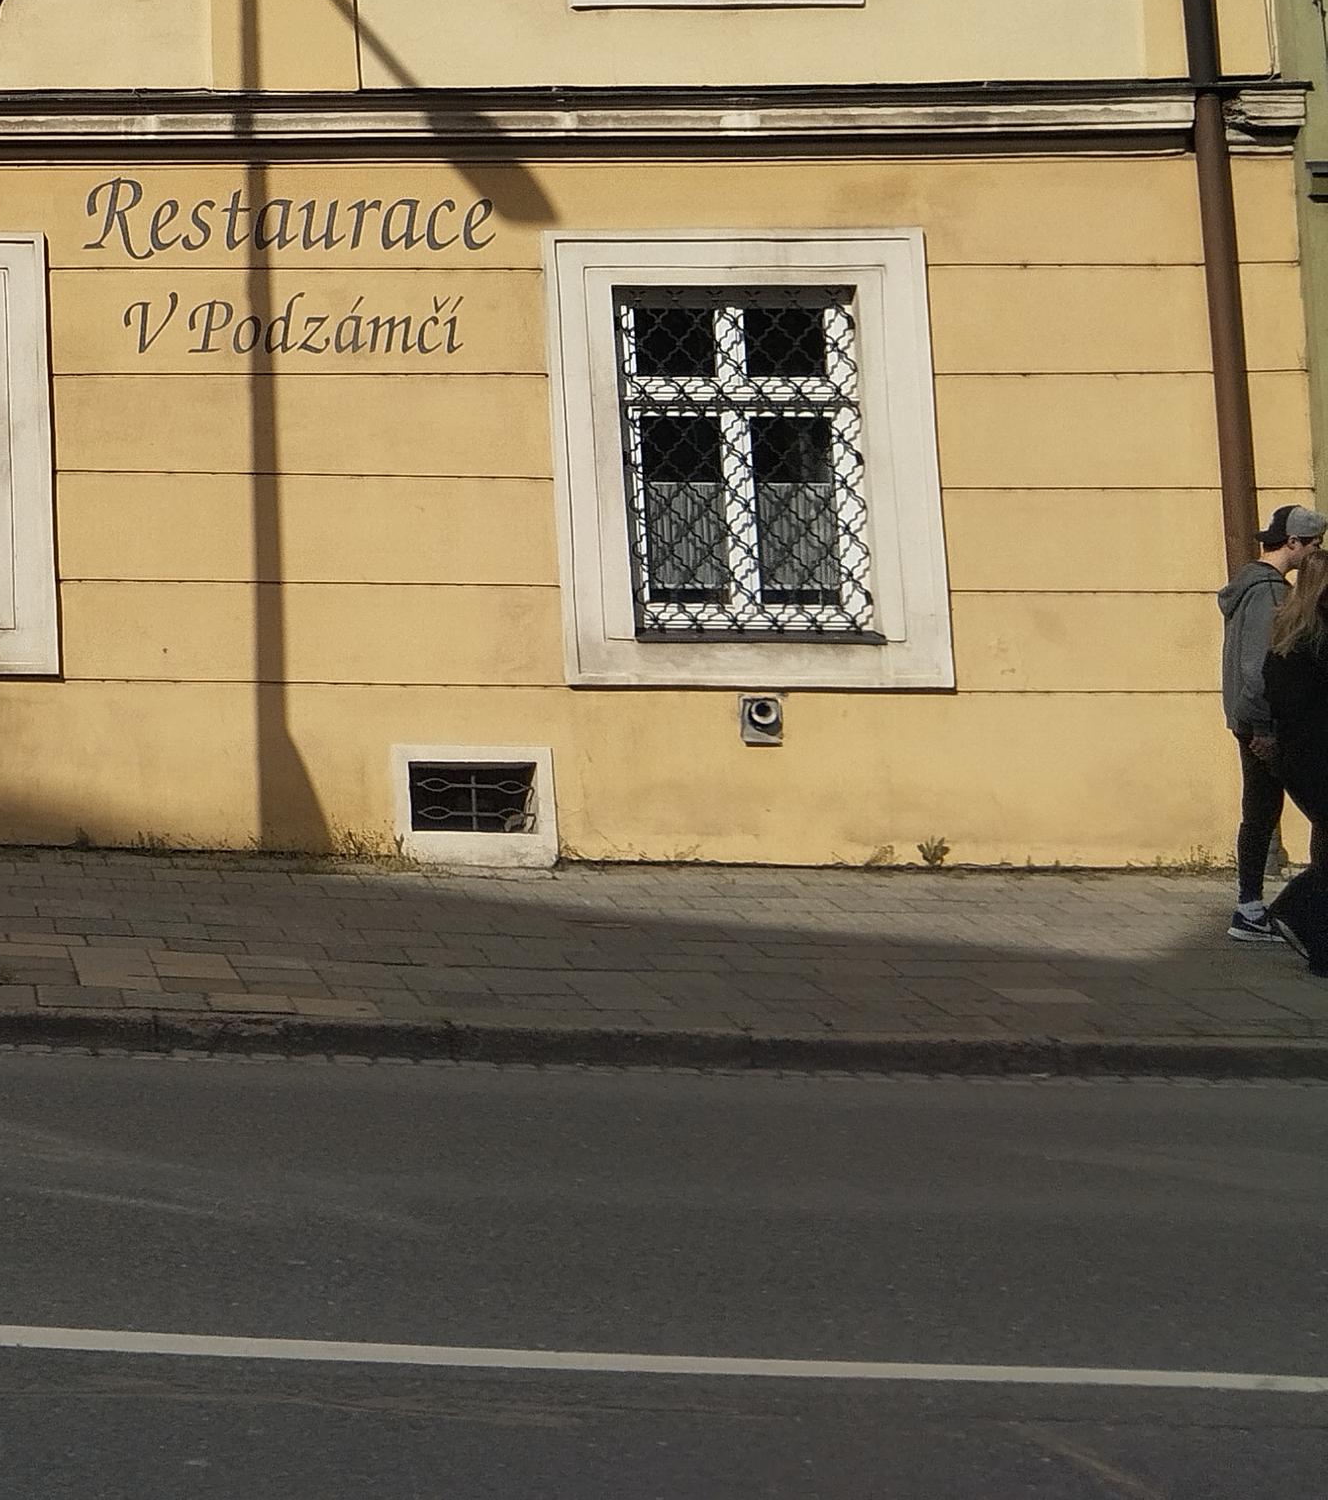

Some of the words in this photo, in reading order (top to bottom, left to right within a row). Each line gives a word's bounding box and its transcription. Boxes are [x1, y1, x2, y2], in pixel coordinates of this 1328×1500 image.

[82, 176, 497, 261] Restaurace
[123, 291, 178, 354] V
[187, 291, 465, 355] Podzámčí
